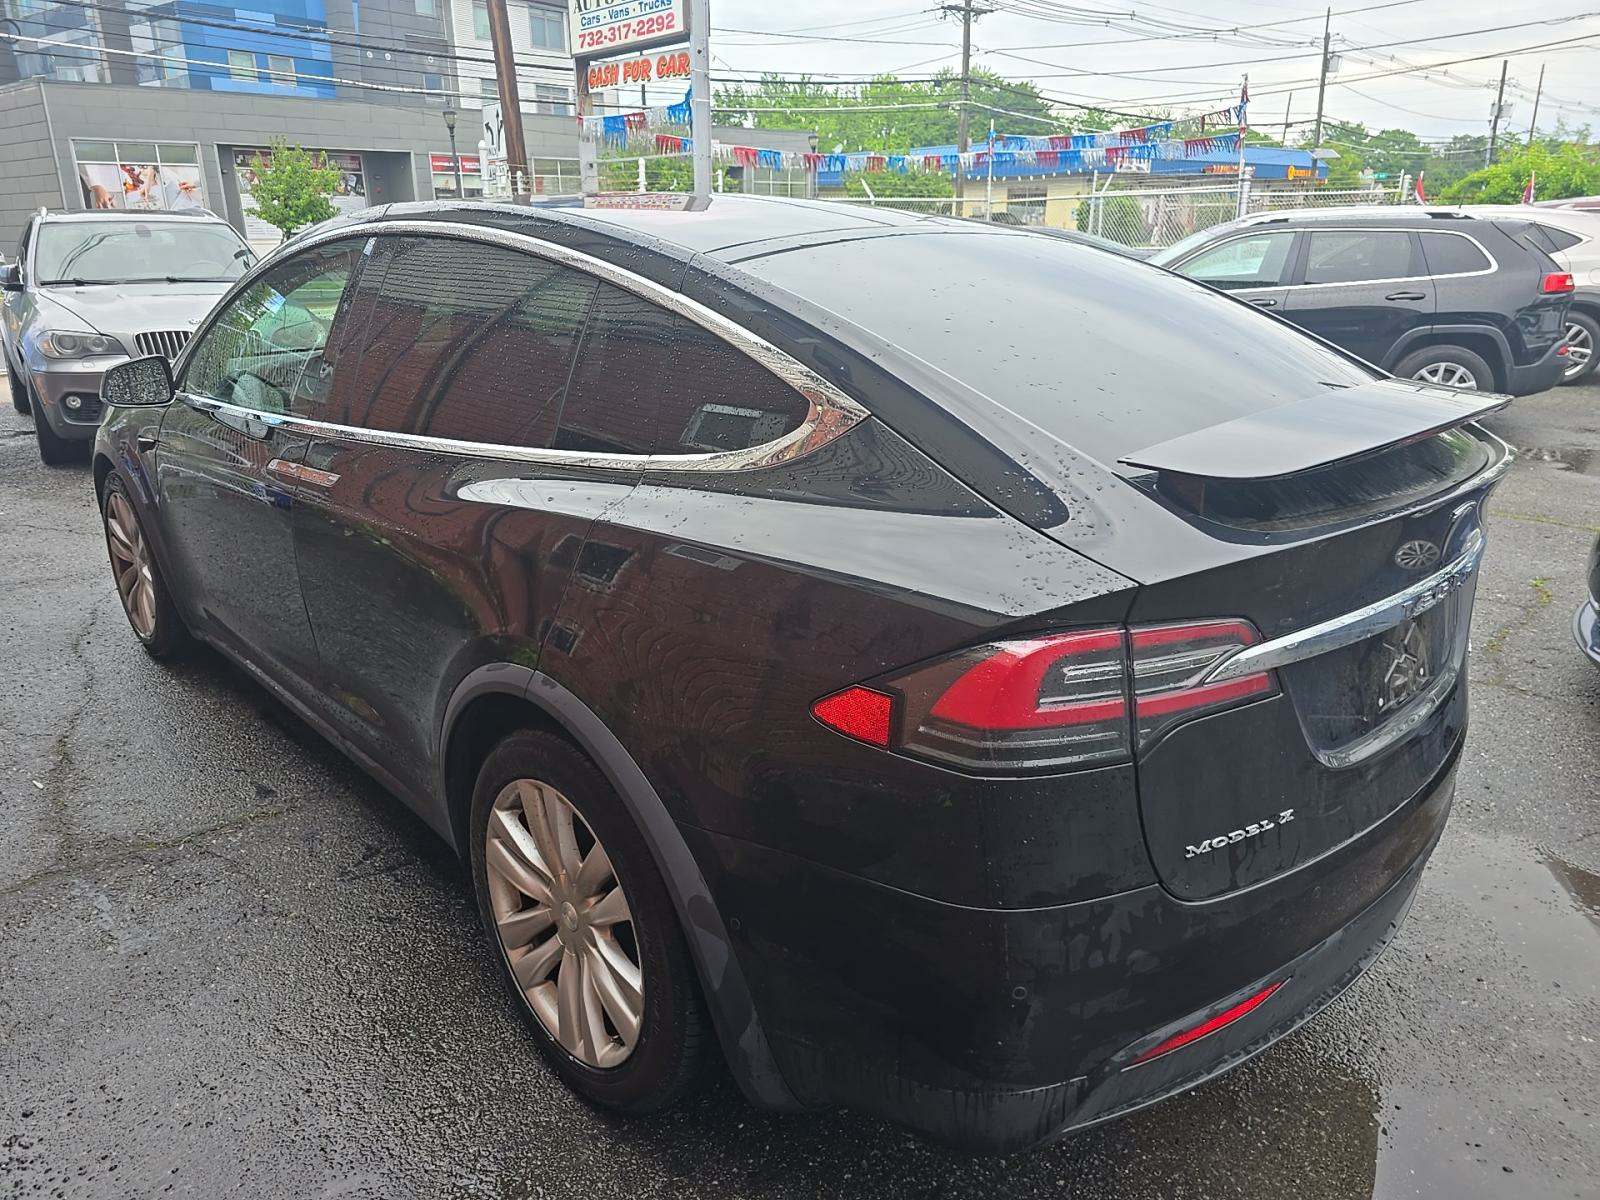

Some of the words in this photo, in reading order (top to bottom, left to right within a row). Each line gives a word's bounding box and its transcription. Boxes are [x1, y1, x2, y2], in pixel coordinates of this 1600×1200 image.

[578, 11, 675, 49] 732-317-2292
[580, 14, 601, 27] Cars
[608, 7, 630, 20] Vans
[638, 0, 672, 13] Trucks
[588, 63, 620, 89] CASH
[622, 57, 653, 83] FOR
[1185, 819, 1275, 858] MODEL
[1279, 808, 1295, 824] X
